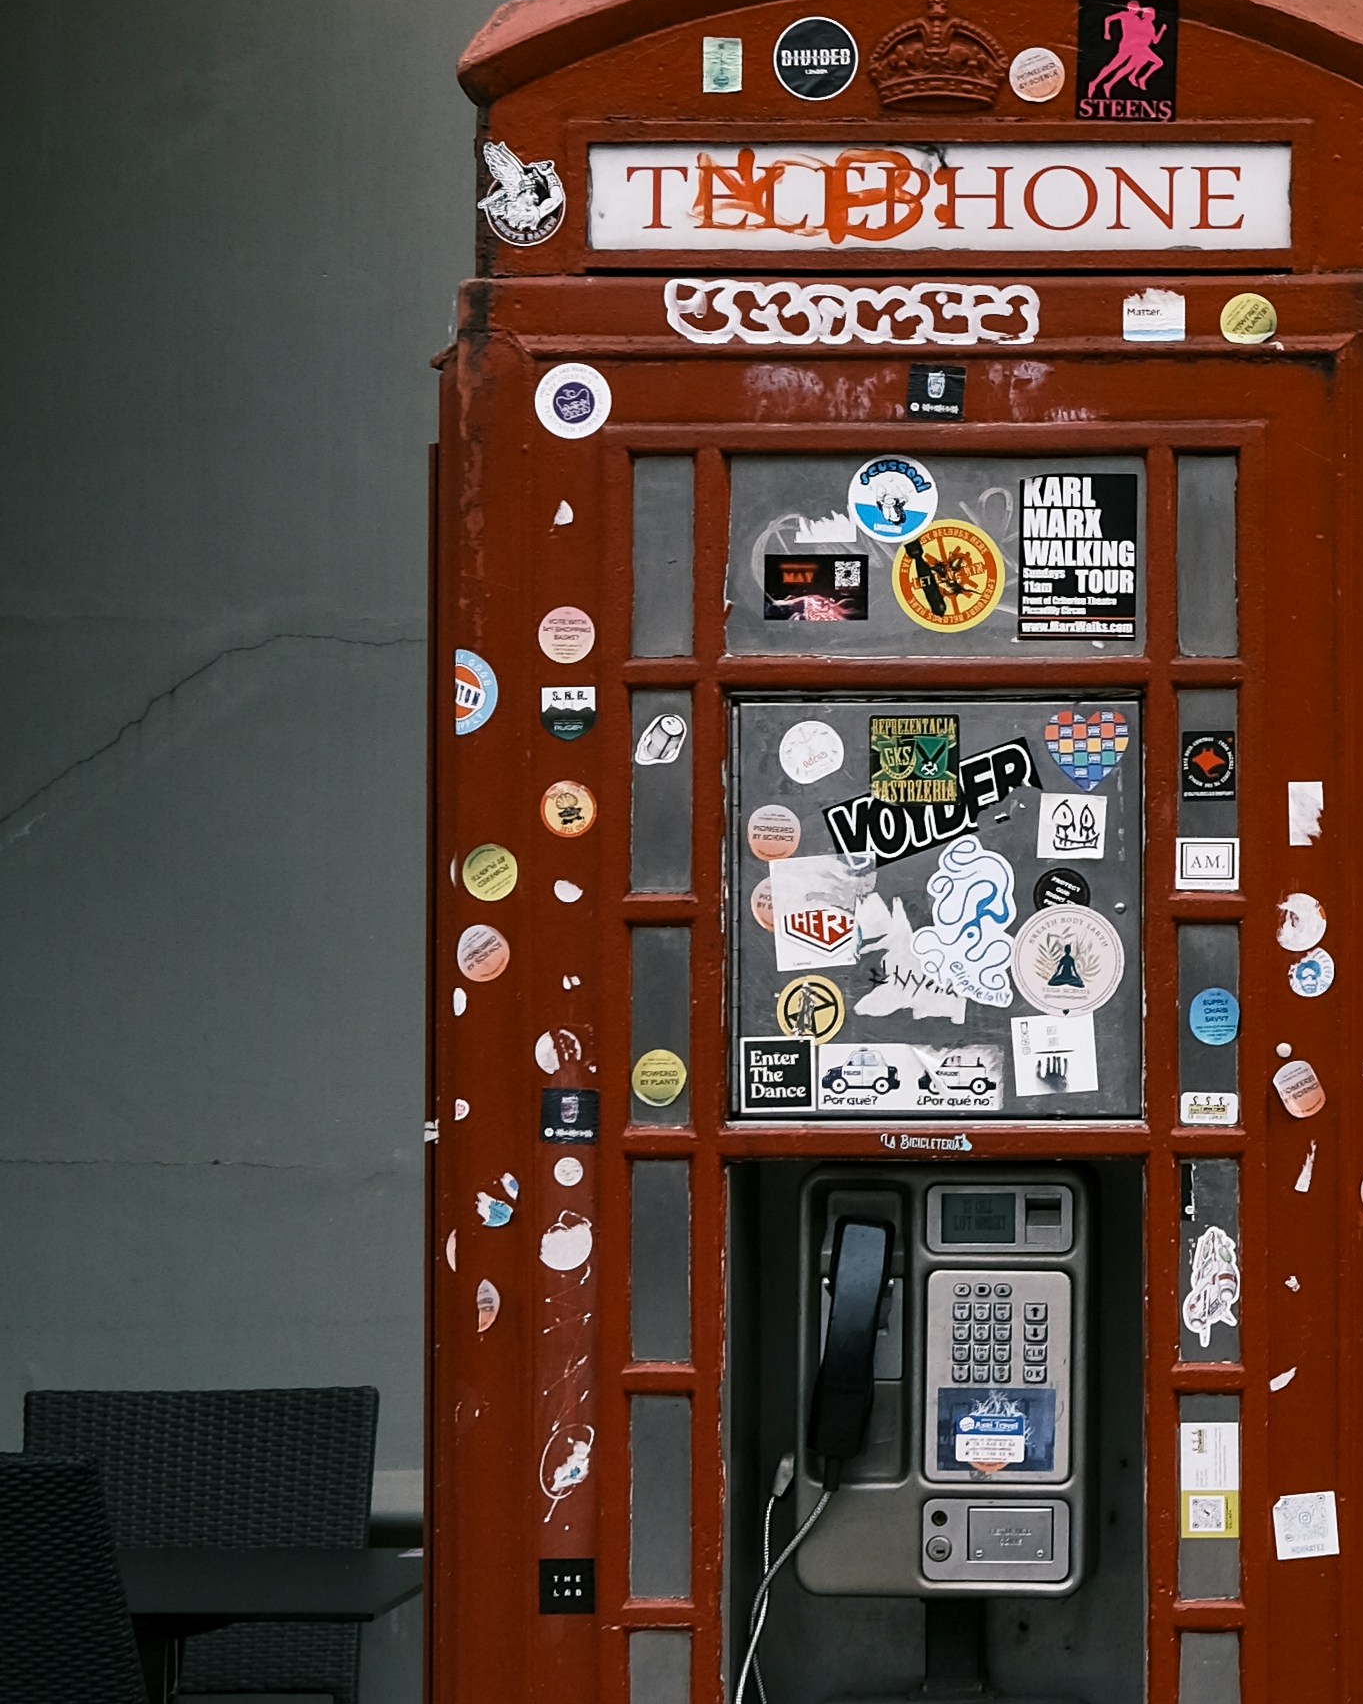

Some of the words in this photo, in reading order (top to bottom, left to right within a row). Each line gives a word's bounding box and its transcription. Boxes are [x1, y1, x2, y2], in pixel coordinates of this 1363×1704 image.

[780, 48, 851, 67] DIVIDED
[1078, 98, 1173, 120] STEENS
[626, 163, 1246, 231] TELEPHONE
[1023, 476, 1096, 507] KARL
[1023, 508, 1103, 538] MARX
[1023, 540, 1135, 567] WALKING
[1075, 569, 1135, 594] TOUR
[871, 717, 957, 736] REPREZENTACJA
[883, 745, 913, 768] GKS
[1190, 854, 1226, 869] AM.
[749, 1050, 800, 1067] Enter
[749, 1067, 784, 1083] The
[749, 1083, 807, 1100] Dance
[1025, 1348, 1044, 1358] CLR
[552, 1574, 583, 1583] THE
[552, 1588, 583, 1597] LAB
